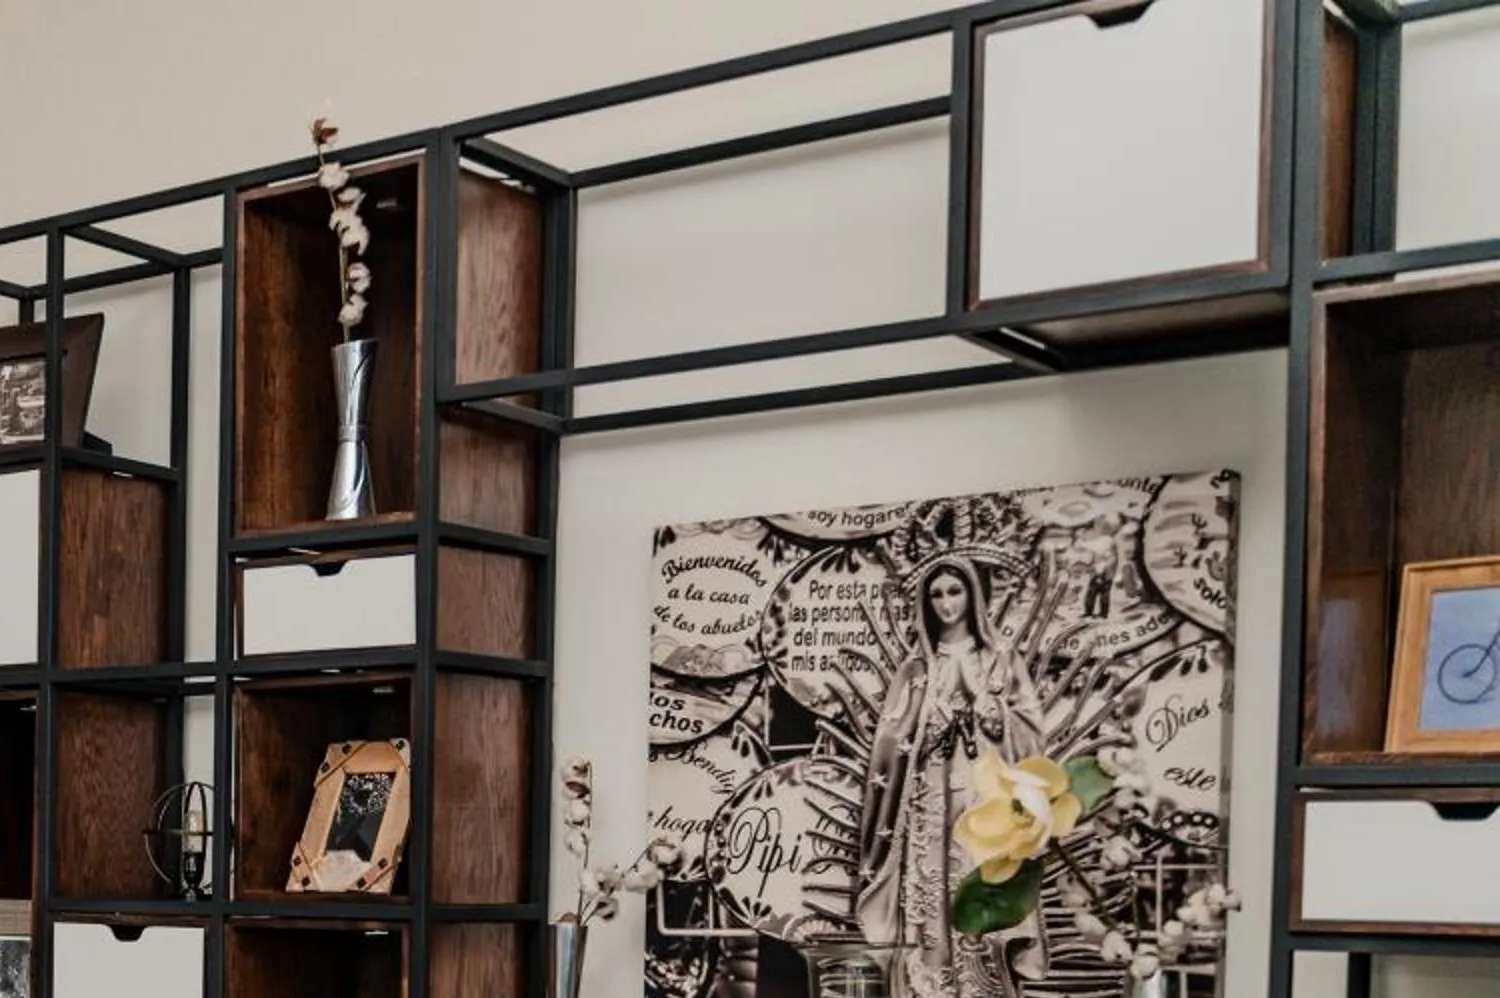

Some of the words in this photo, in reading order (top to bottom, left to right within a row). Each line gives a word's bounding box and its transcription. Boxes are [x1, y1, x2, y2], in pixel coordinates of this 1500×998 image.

[661, 555, 768, 588] Bienvenidos
[666, 585, 680, 600] a
[685, 583, 705, 601] la
[709, 588, 751, 605] casa
[809, 579, 833, 601] Por
[672, 611, 697, 633] los
[811, 604, 872, 625] person
[793, 627, 819, 647] del
[821, 627, 877, 647] mundo
[791, 650, 816, 672] mis
[1163, 765, 1217, 792] este
[726, 806, 804, 899] Pipi
